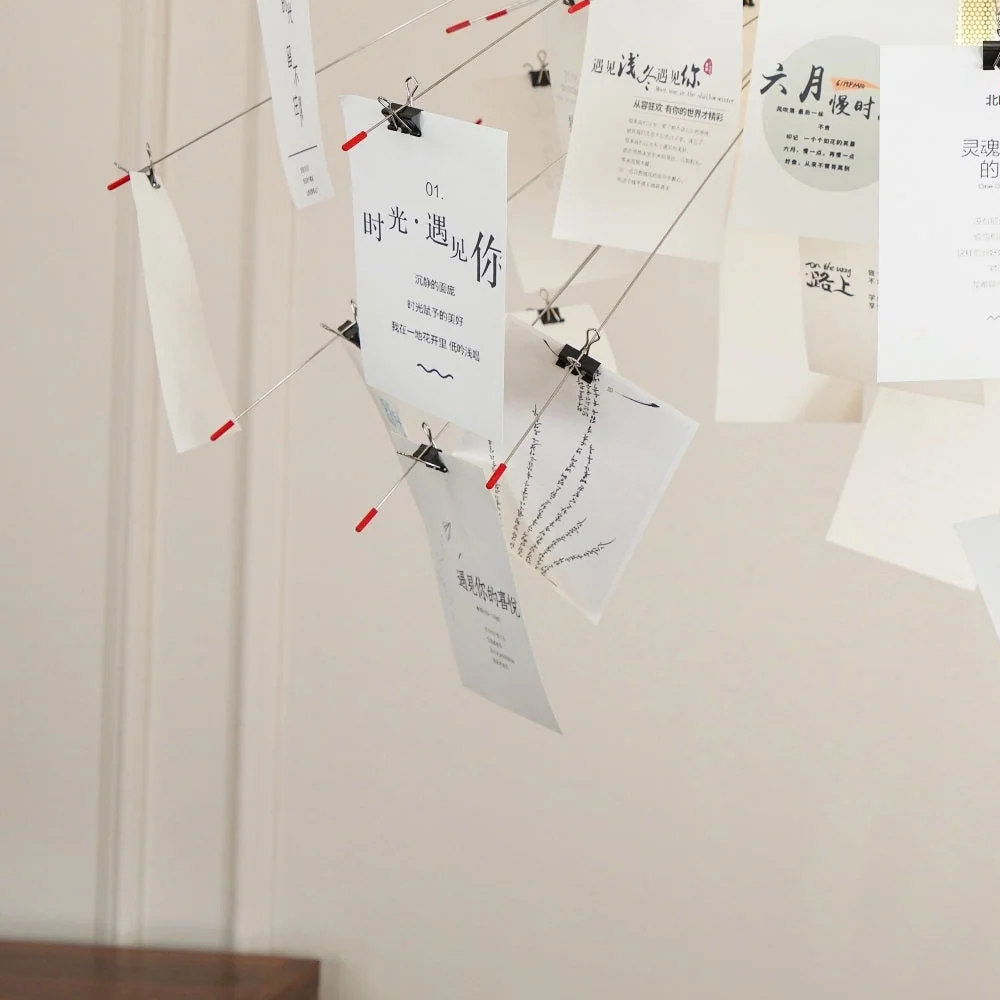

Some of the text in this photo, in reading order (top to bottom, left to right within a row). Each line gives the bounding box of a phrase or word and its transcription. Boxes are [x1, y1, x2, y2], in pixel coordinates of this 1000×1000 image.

[591, 52, 701, 92] 遇见浅冬遇见你
[760, 62, 825, 103] 六月
[633, 99, 724, 122] 从容狂欢 有你的世界才精彩
[828, 94, 880, 120] 慢时
[836, 266, 852, 278] way
[407, 299, 464, 327] 时光赋予的美好
[391, 320, 480, 362] 我在一地花开里 低吟浅唱
